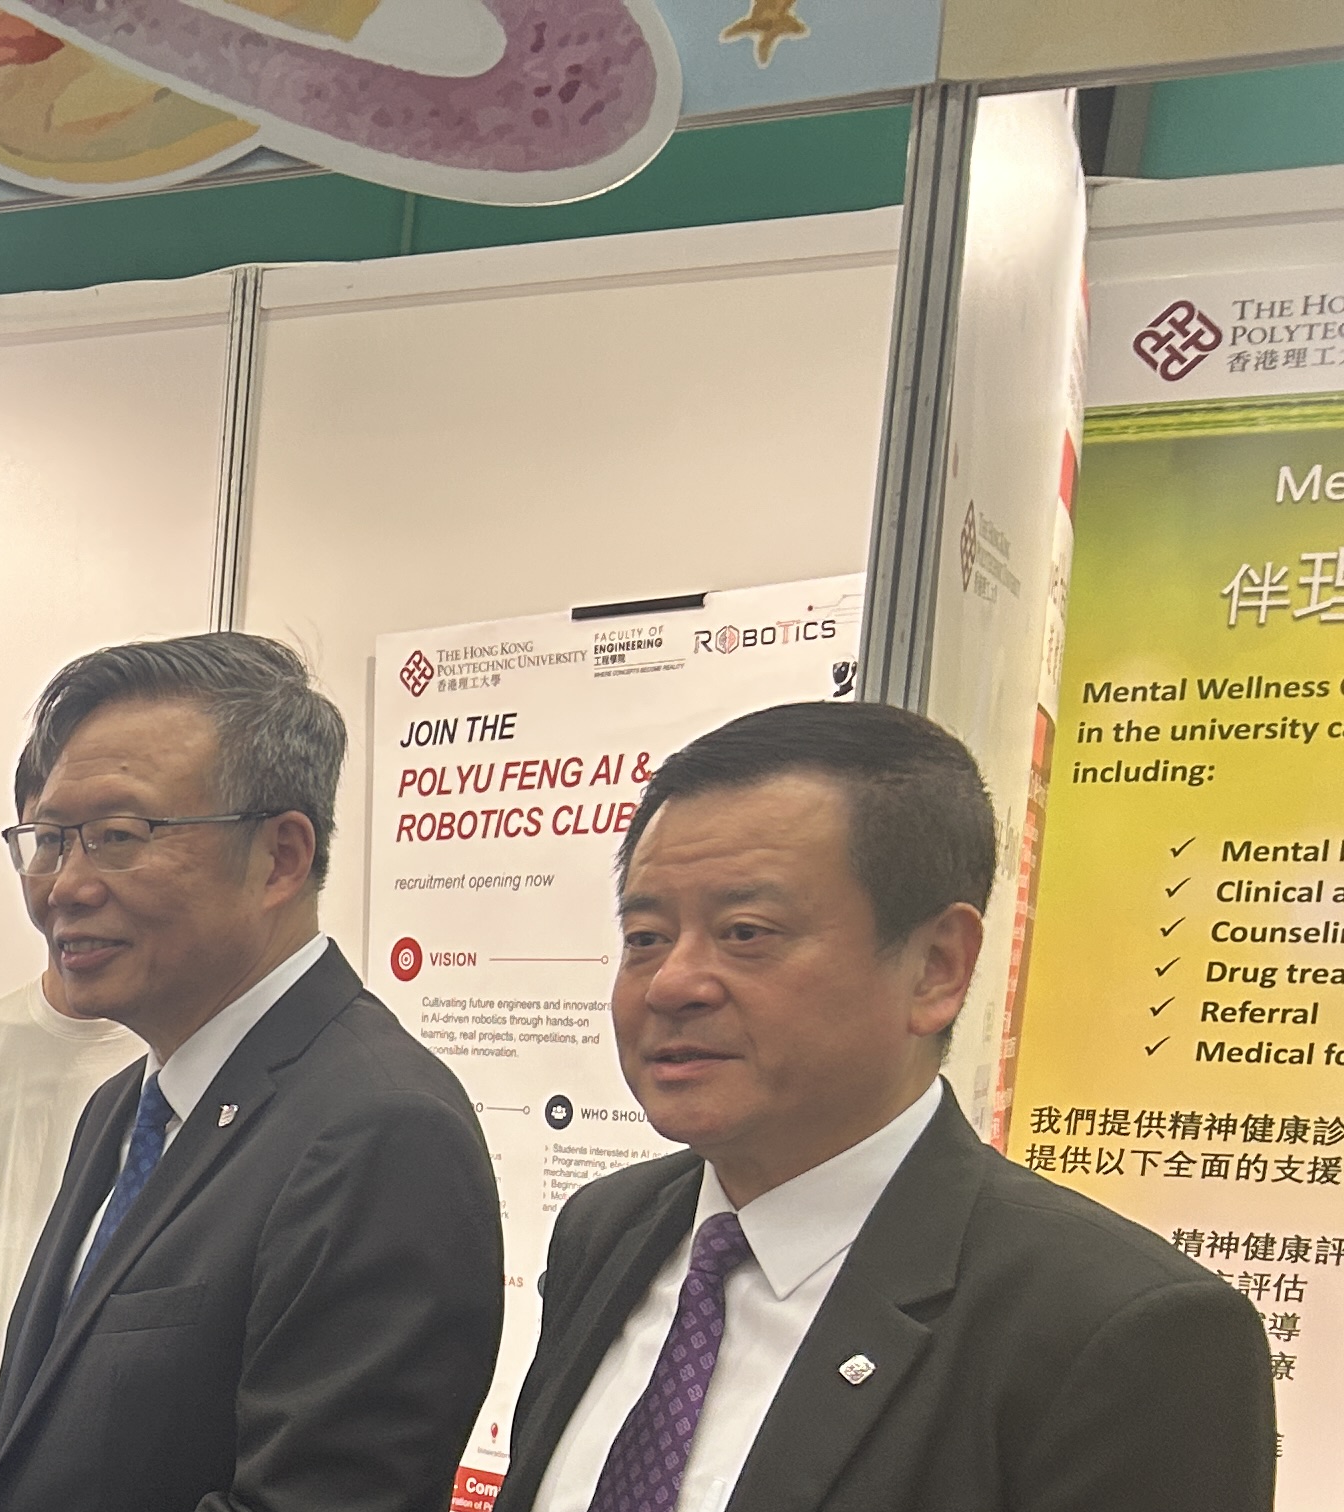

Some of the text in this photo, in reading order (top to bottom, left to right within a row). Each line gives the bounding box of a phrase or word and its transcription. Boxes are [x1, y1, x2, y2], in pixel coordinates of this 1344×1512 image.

[1231, 298, 1295, 321] THE
[1226, 345, 1344, 374] 香港理工
[593, 627, 643, 643] FACULTY
[593, 637, 664, 655] ENGINEERING
[435, 640, 534, 662] THE HONG KONG
[436, 650, 588, 678] POLYTECHNIC UNIVERSITY
[1082, 677, 1188, 704] Mental
[1196, 675, 1331, 700] Wellness
[399, 712, 518, 748] JOIN THE
[1076, 721, 1104, 744] in
[1112, 719, 1161, 743] the
[1169, 716, 1320, 745] university
[397, 751, 653, 798] POLYU FENG AI &
[1072, 759, 1216, 787] including:
[395, 802, 637, 843] ROBOTICS CLUB
[1221, 838, 1330, 862] Mental
[394, 871, 555, 892] recruitment opening now
[1216, 879, 1324, 903] Clinical
[429, 952, 477, 967] VISION
[1205, 960, 1279, 989] Drug
[421, 996, 467, 1011] Cultivating
[468, 997, 495, 1009] future
[497, 999, 541, 1012] engineers
[543, 998, 561, 1010] and
[1200, 1000, 1320, 1025] Referral
[430, 1012, 470, 1024] AI-driven
[471, 1013, 507, 1025] robotics
[509, 1014, 543, 1028] through
[546, 1015, 590, 1027] hands-on
[459, 1029, 477, 1041] real
[581, 1033, 601, 1044] and
[1195, 1040, 1316, 1065] Medical
[580, 1107, 609, 1121] WHO
[465, 1477, 501, 1498] Com
